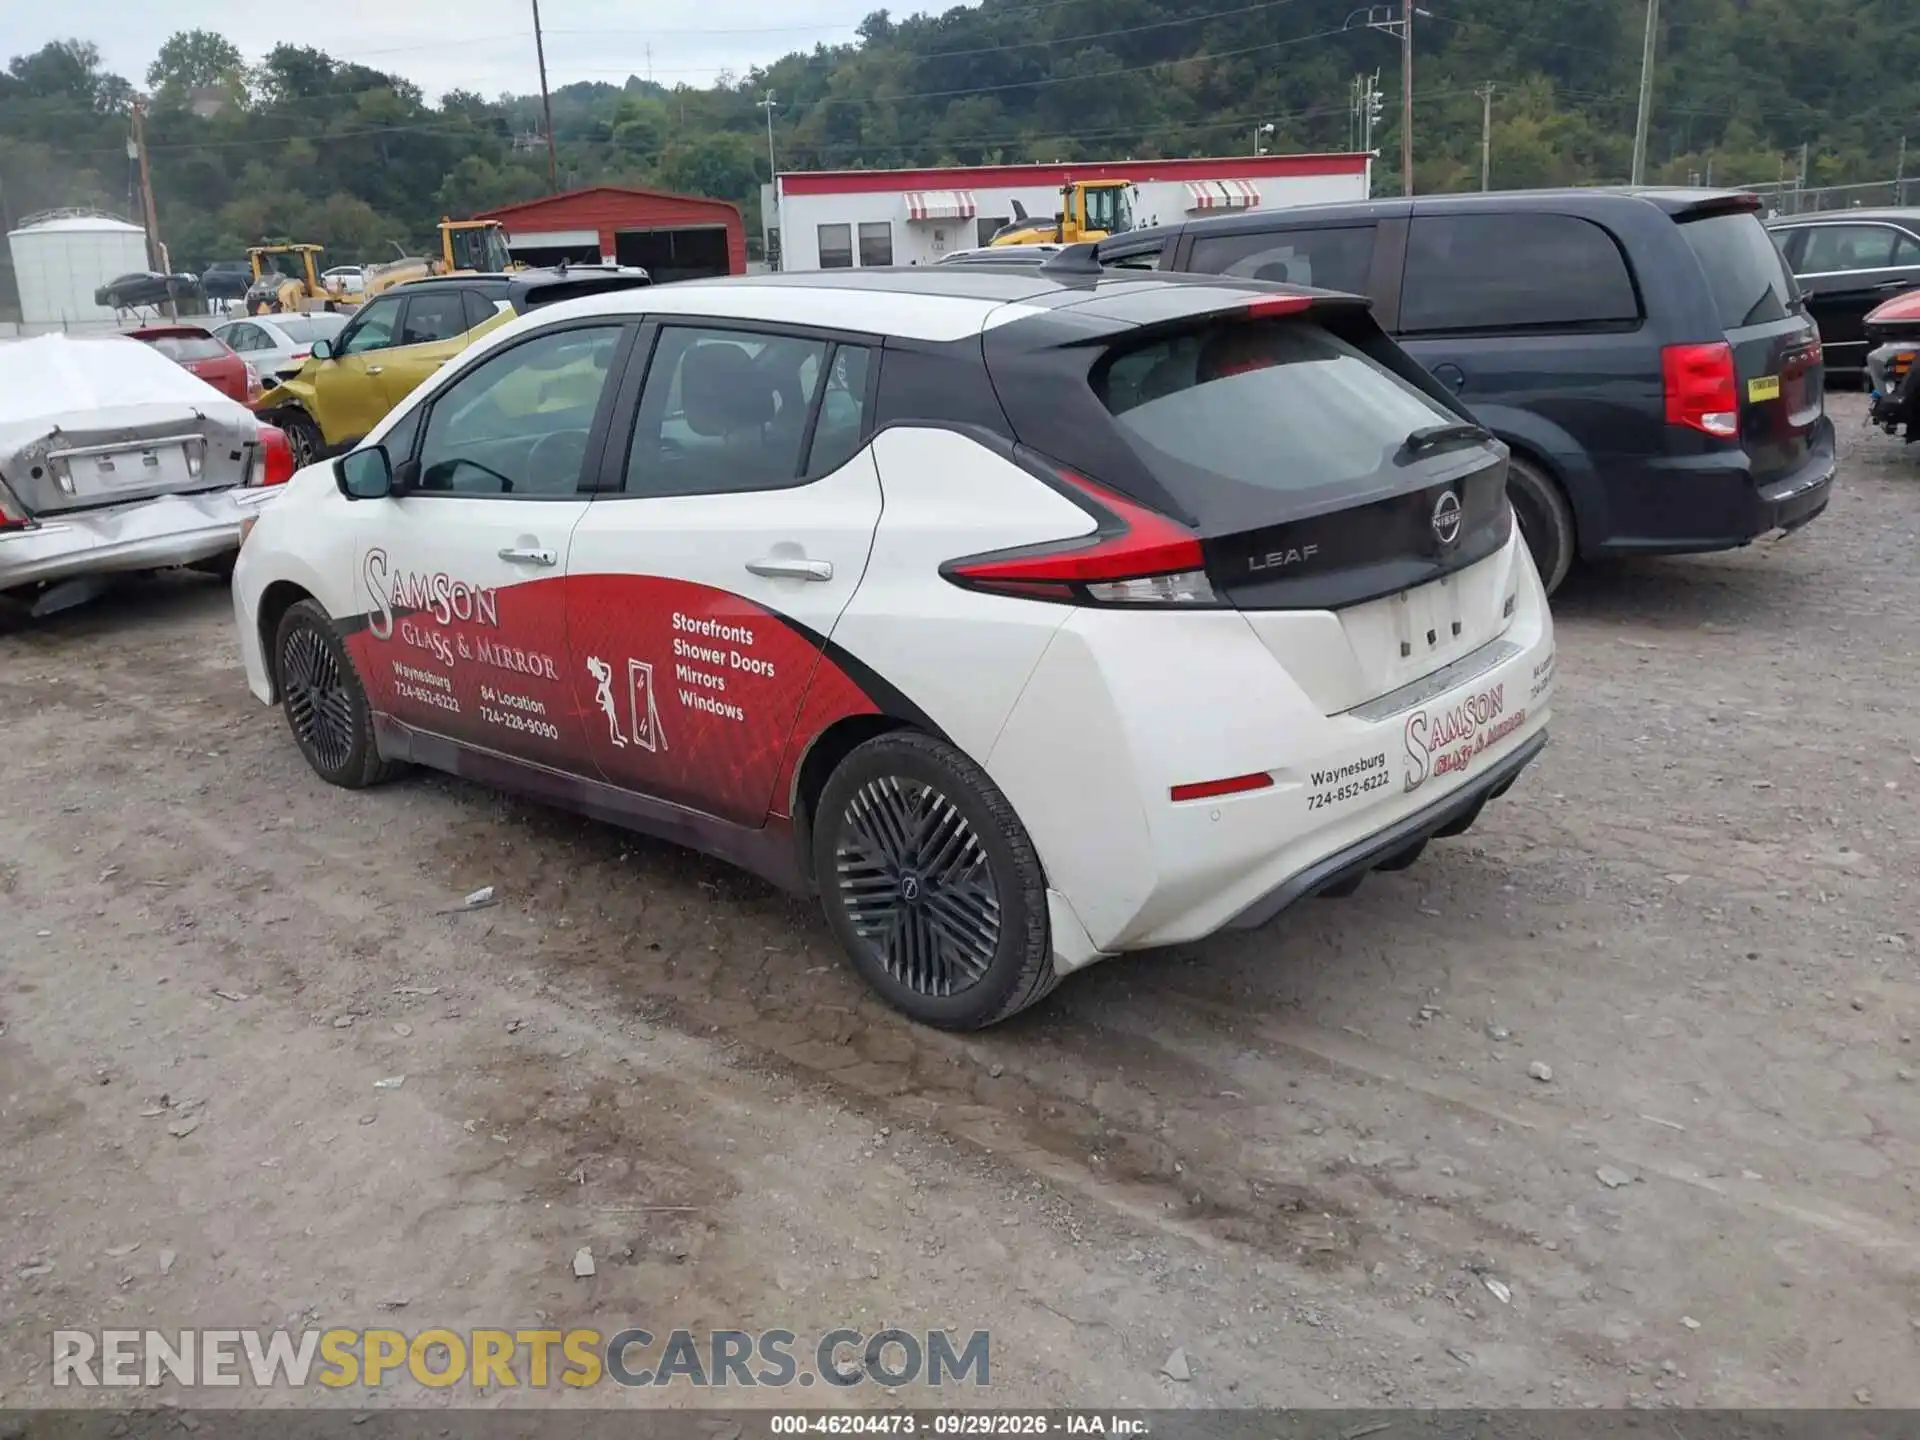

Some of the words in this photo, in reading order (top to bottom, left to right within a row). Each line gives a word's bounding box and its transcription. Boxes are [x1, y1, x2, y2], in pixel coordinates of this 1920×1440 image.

[1248, 544, 1318, 571] LEAF
[363, 547, 498, 640] SAMSON
[672, 612, 753, 645] Storefronts
[402, 620, 454, 667] GLASS
[457, 632, 473, 660] &
[476, 636, 559, 681] MIRROR
[674, 638, 725, 666] Shower
[730, 651, 775, 677] Doors
[392, 661, 451, 691] Waynesburg
[676, 664, 725, 691] Mirrors
[394, 680, 460, 712] 724-852-6222
[480, 685, 495, 700] 84
[499, 689, 545, 715] Location
[679, 688, 744, 721] Windows
[480, 706, 559, 740] 724-228-9090
[1404, 683, 1503, 793] SAMSON
[1310, 752, 1385, 787] Waynesburg
[1307, 770, 1390, 810] 724-852-6222
